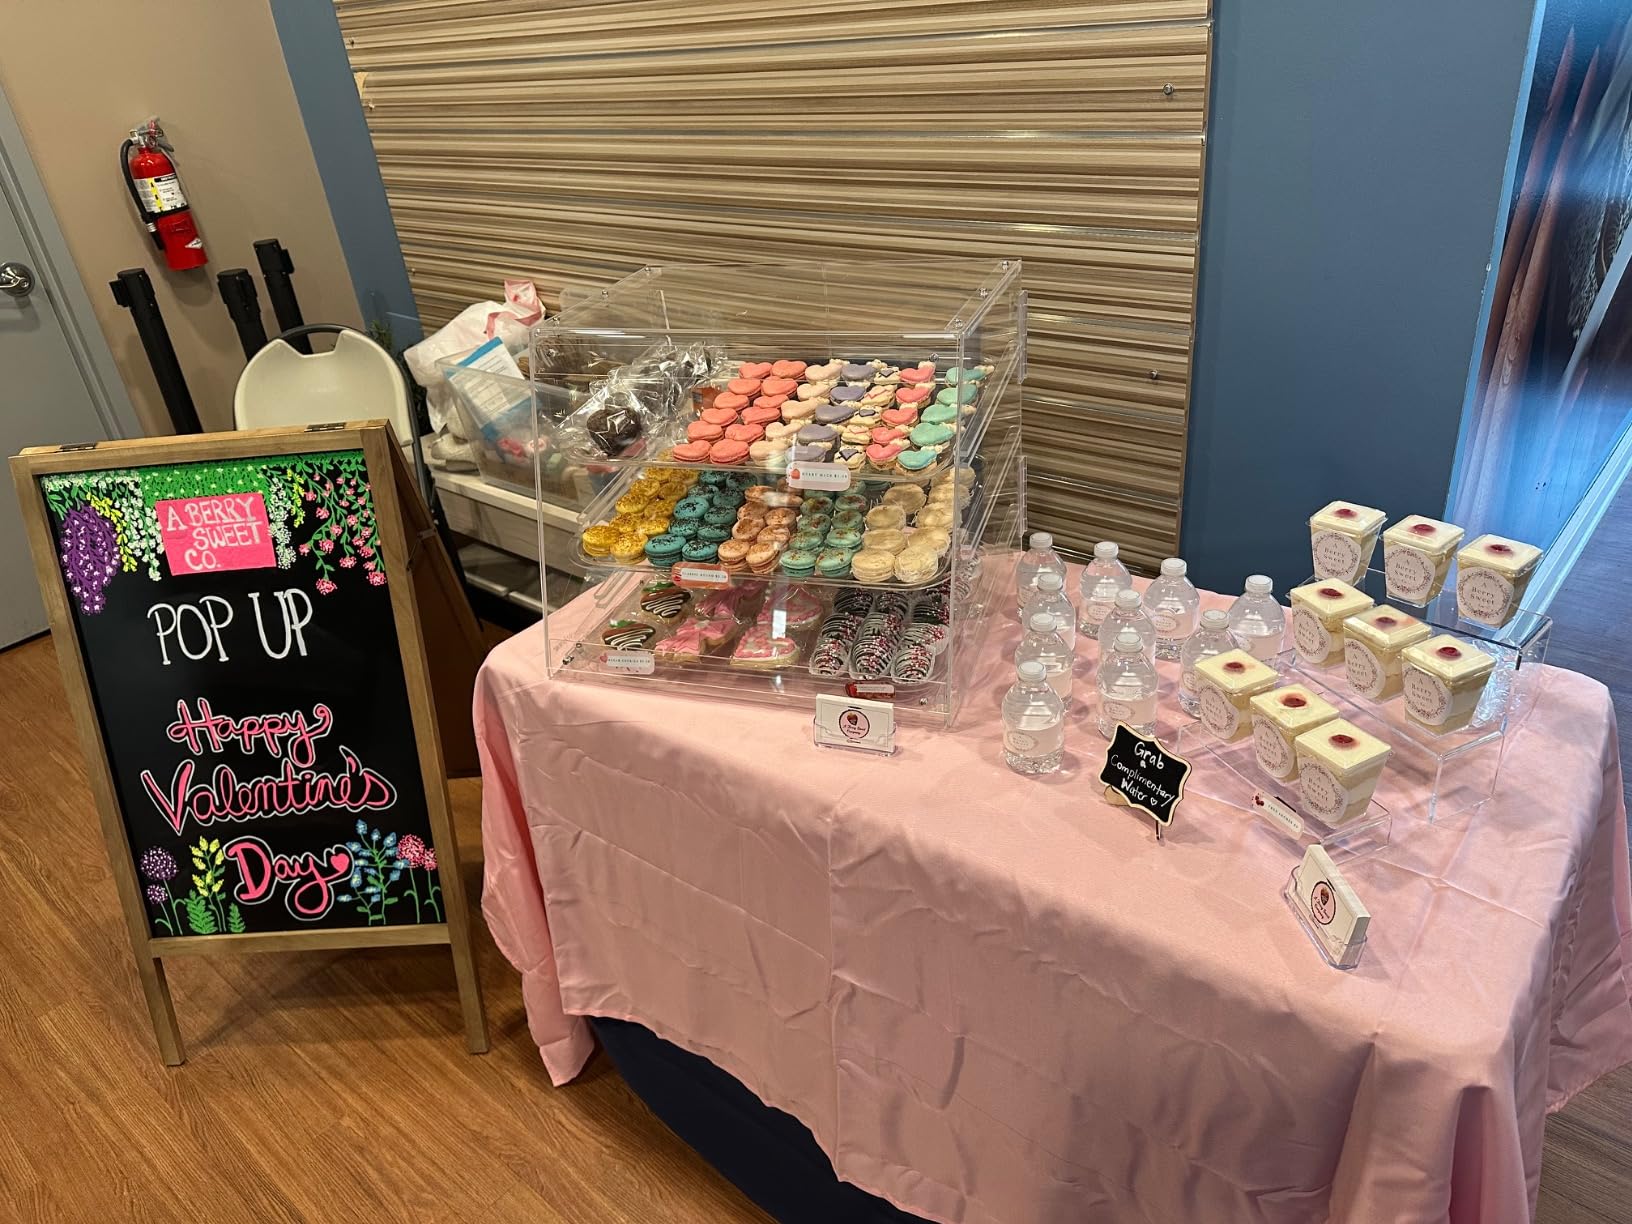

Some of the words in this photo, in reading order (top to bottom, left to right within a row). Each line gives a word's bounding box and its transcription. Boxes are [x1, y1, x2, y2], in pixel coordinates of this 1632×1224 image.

[166, 505, 188, 532] A
[184, 496, 257, 527] BERRY
[192, 521, 263, 551] SWEET
[184, 548, 221, 571] CO.
[147, 595, 234, 666] POP
[248, 588, 314, 660] UP
[166, 697, 334, 768] Happy
[1134, 741, 1165, 770] Grab
[1140, 760, 1147, 769] a
[140, 745, 398, 836] Valentine's
[1110, 754, 1176, 808] Complimentary
[1120, 777, 1148, 801] Water
[224, 835, 349, 921] Day
